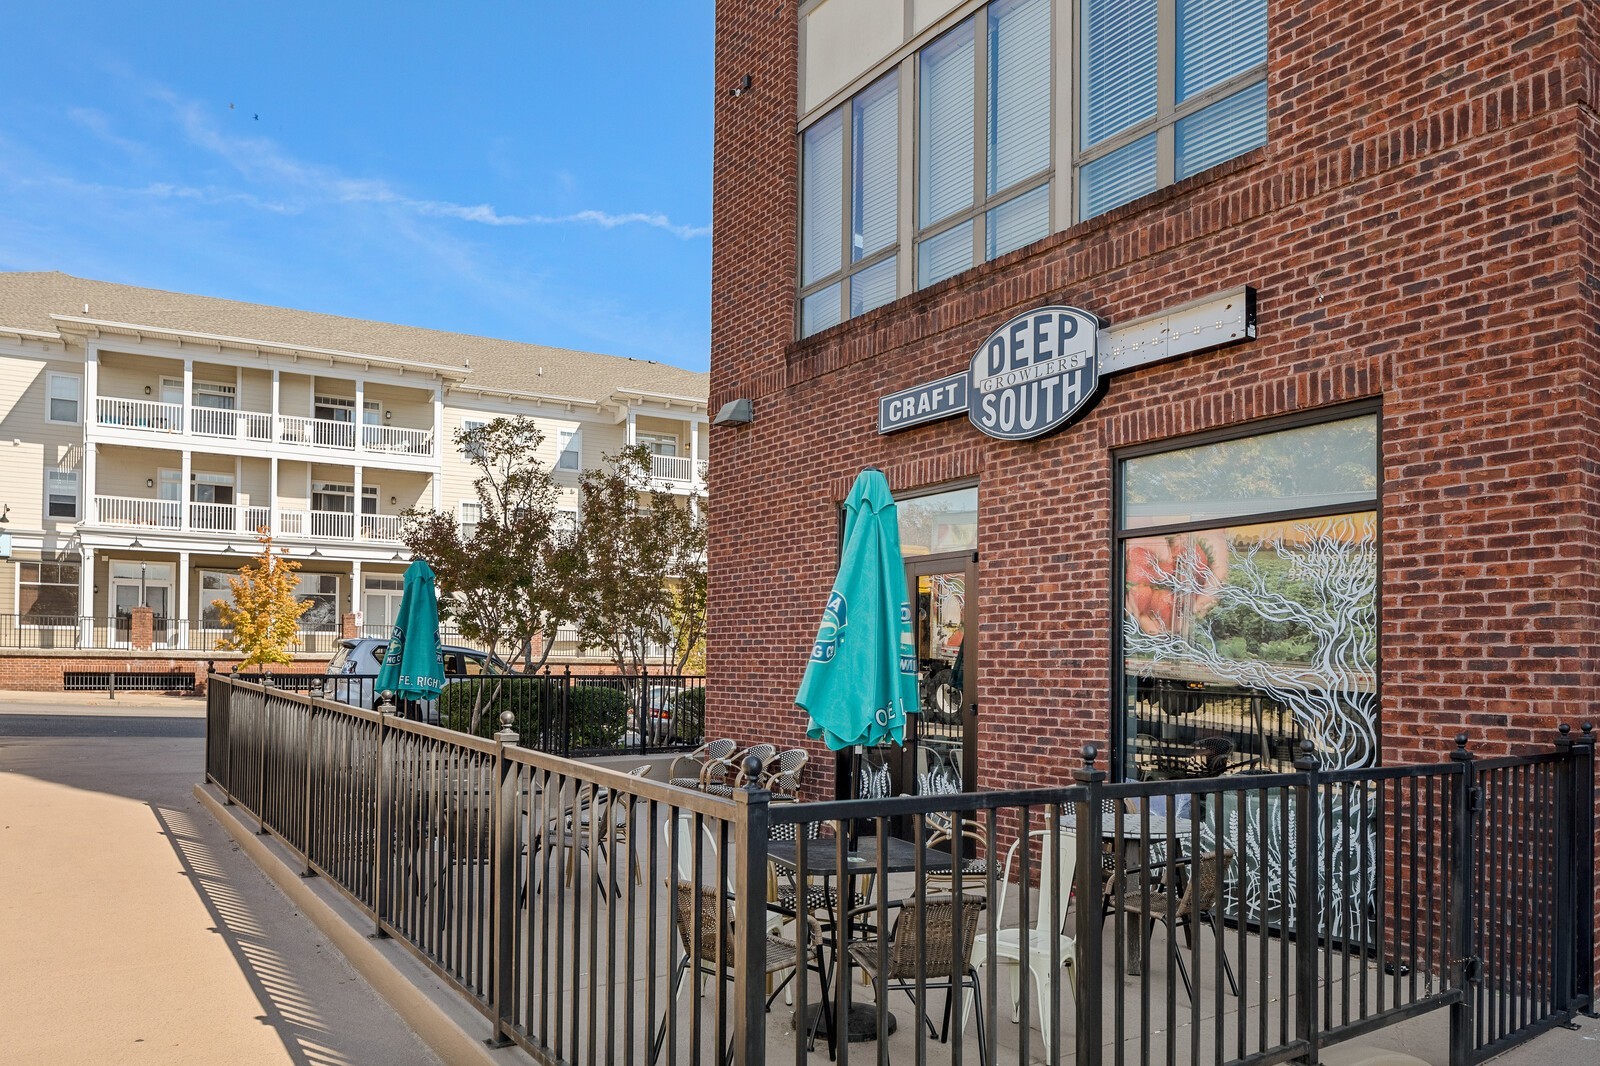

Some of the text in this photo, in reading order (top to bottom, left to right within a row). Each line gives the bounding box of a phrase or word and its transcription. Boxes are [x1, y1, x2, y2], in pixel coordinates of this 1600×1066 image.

[987, 313, 1079, 377] DEEP
[983, 354, 1079, 392] GROWLERS
[888, 382, 959, 422] CRAFT
[981, 370, 1082, 432] SOUTH
[417, 676, 441, 688] RIGH
